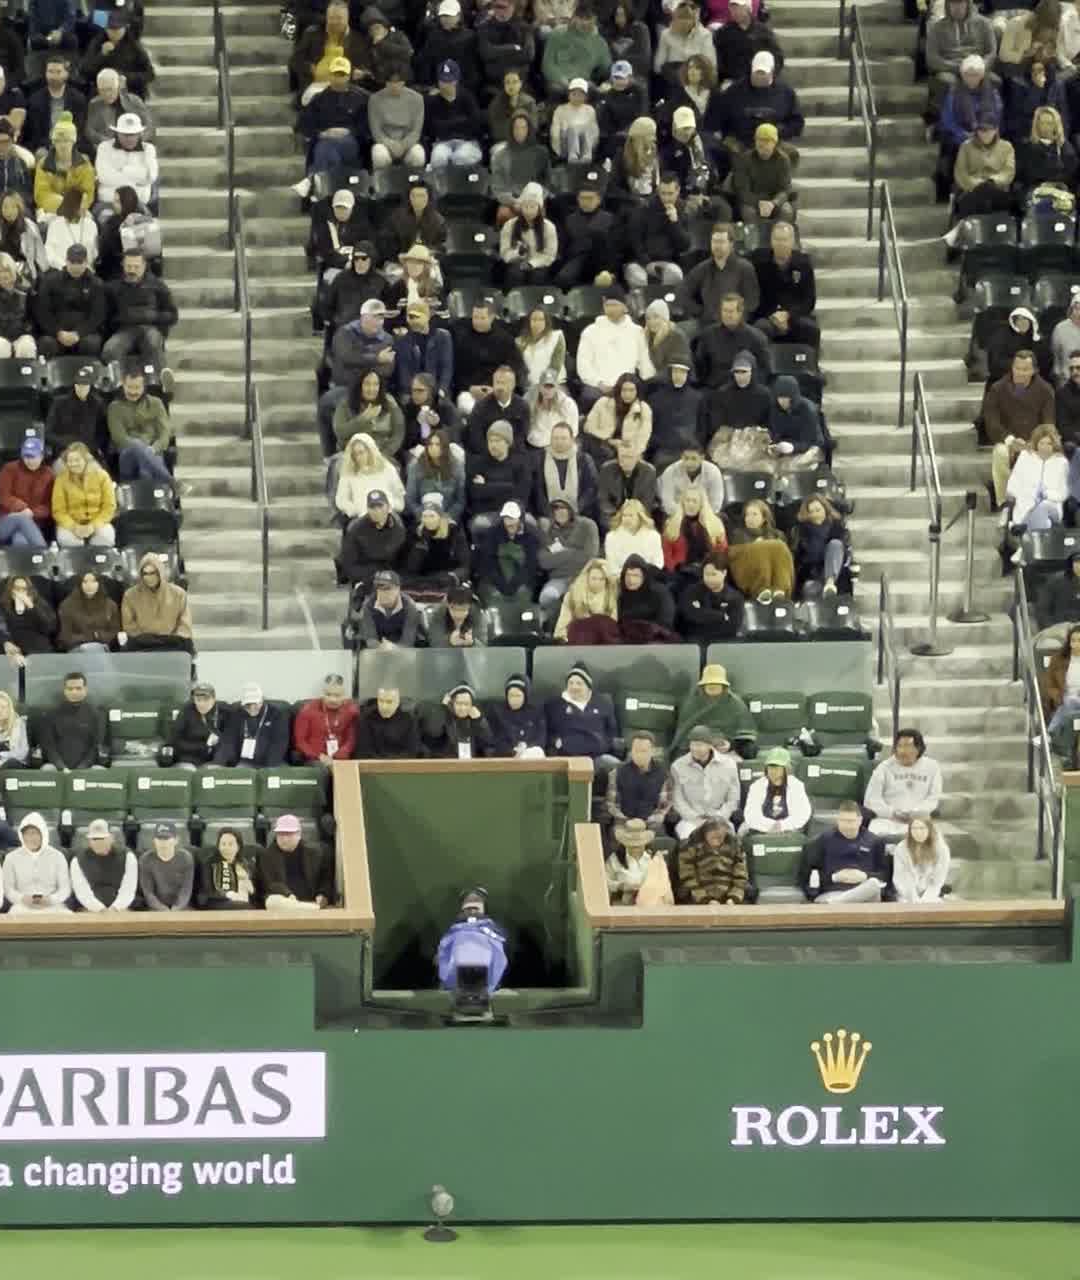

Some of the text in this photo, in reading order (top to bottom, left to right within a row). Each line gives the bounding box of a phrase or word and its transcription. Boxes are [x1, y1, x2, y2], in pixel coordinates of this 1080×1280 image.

[730, 1105, 946, 1147] ROLEX
[23, 1156, 183, 1194] changing
[192, 1154, 297, 1185] world
